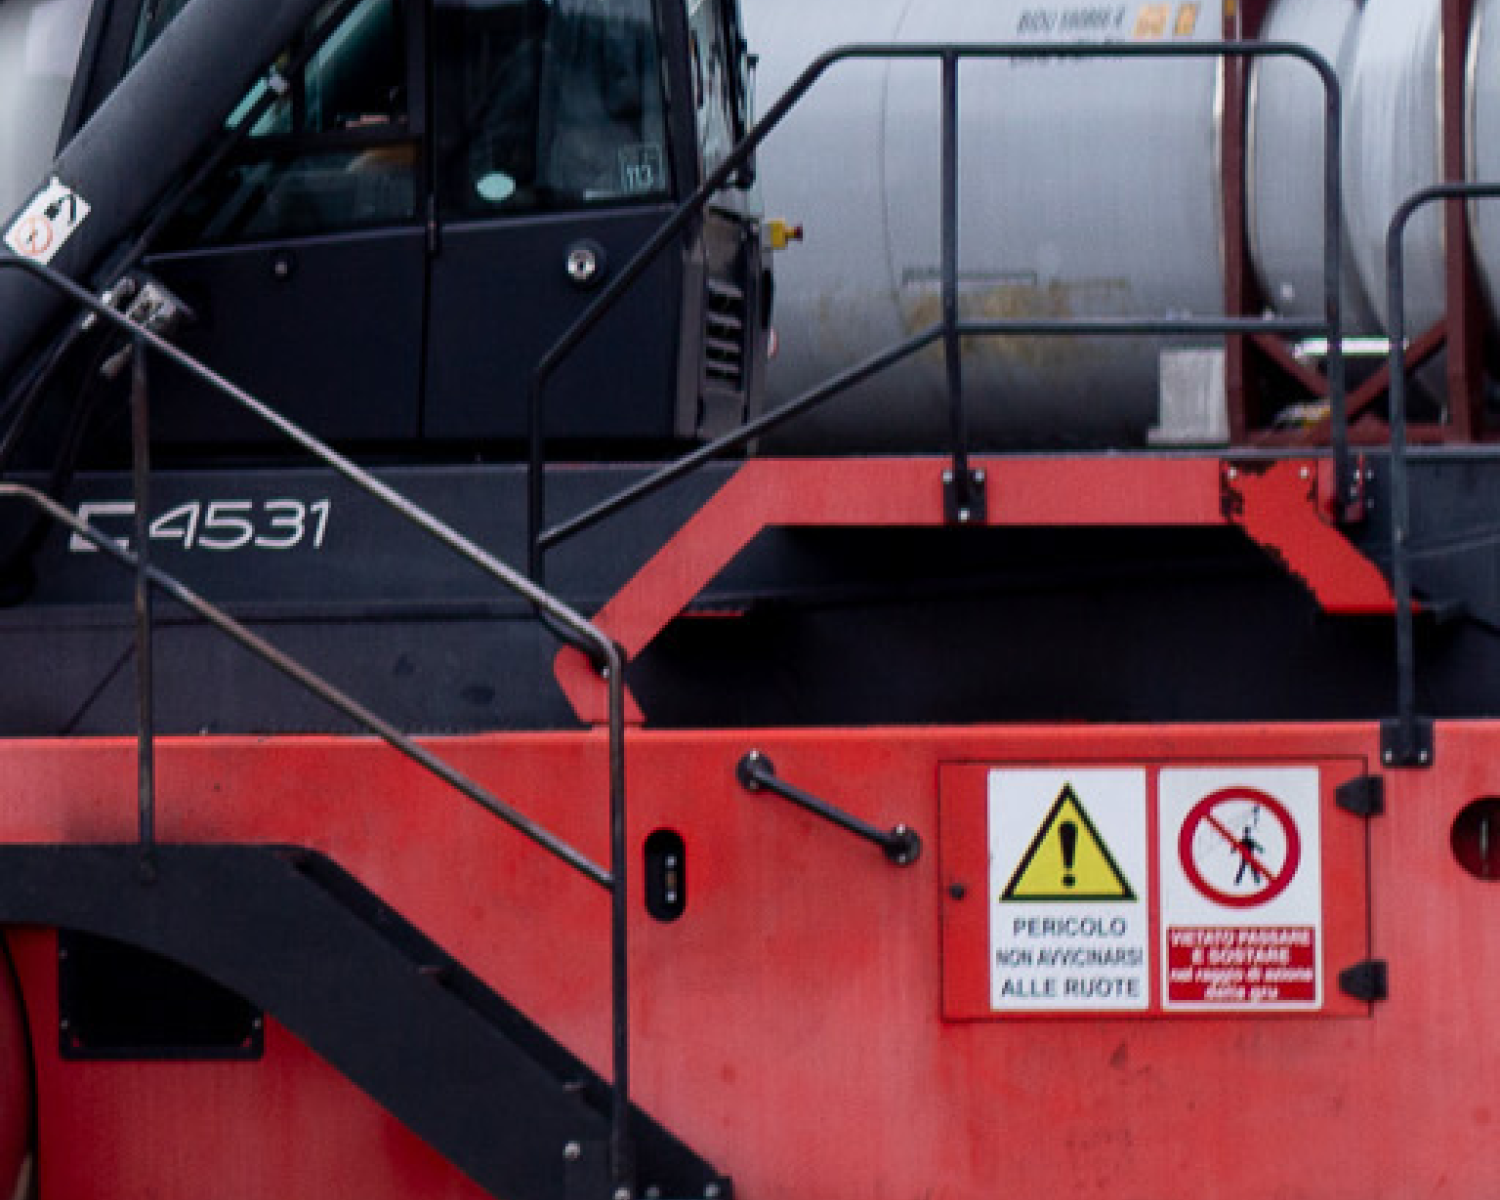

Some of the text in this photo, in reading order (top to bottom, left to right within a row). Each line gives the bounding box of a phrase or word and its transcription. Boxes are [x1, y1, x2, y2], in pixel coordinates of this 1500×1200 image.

[1013, 916, 1128, 938] PERICOLO
[995, 947, 1144, 967] NON AVVICINARSI
[1001, 977, 1141, 998] ALLE RUOTE
